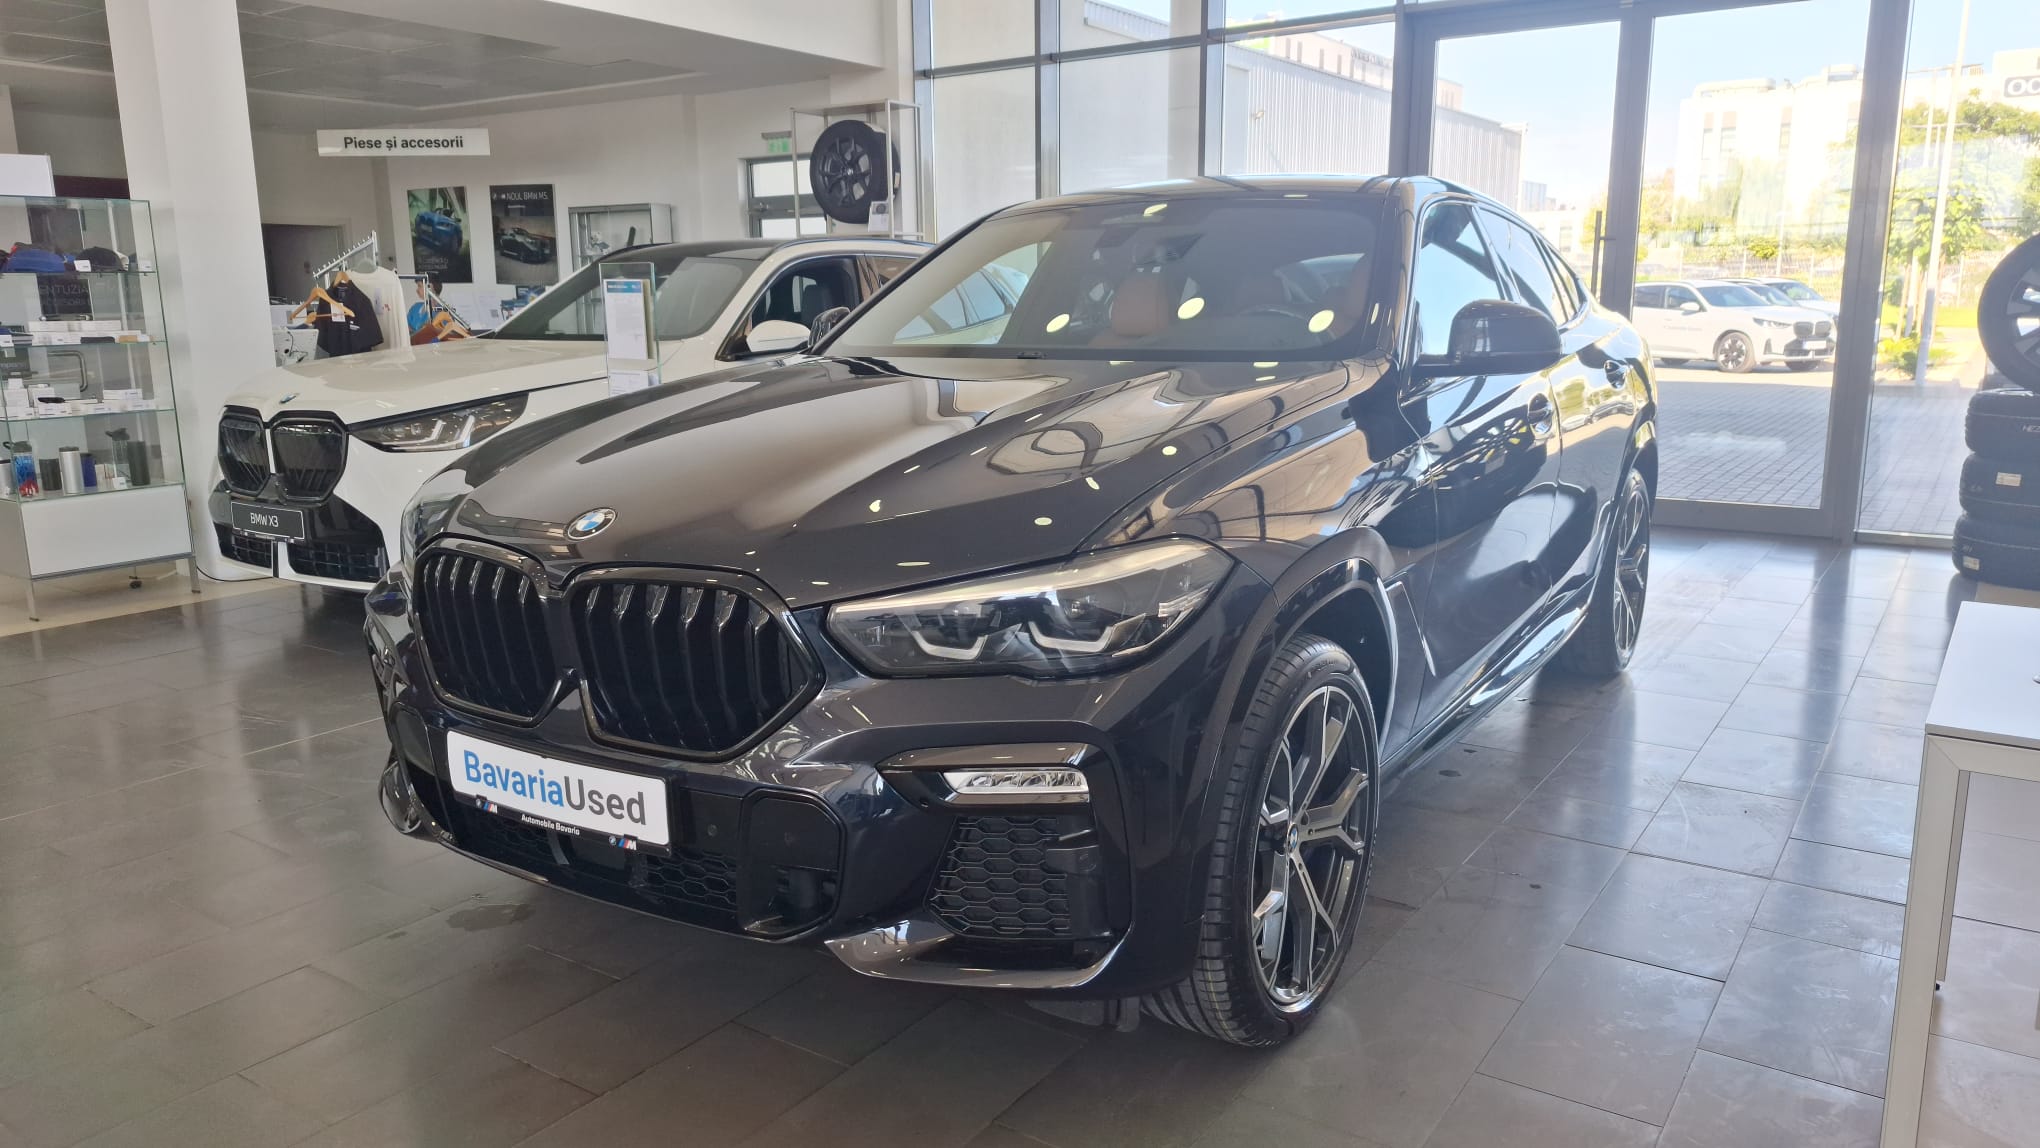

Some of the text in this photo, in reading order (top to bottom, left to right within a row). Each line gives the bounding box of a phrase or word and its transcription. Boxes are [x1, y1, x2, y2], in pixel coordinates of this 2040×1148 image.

[343, 135, 464, 151] Piese și accesorii
[523, 191, 538, 201] BMW
[250, 512, 279, 528] BMW X3
[463, 749, 647, 826] BavariaUsed
[521, 813, 580, 836] Automobile Bavaria
